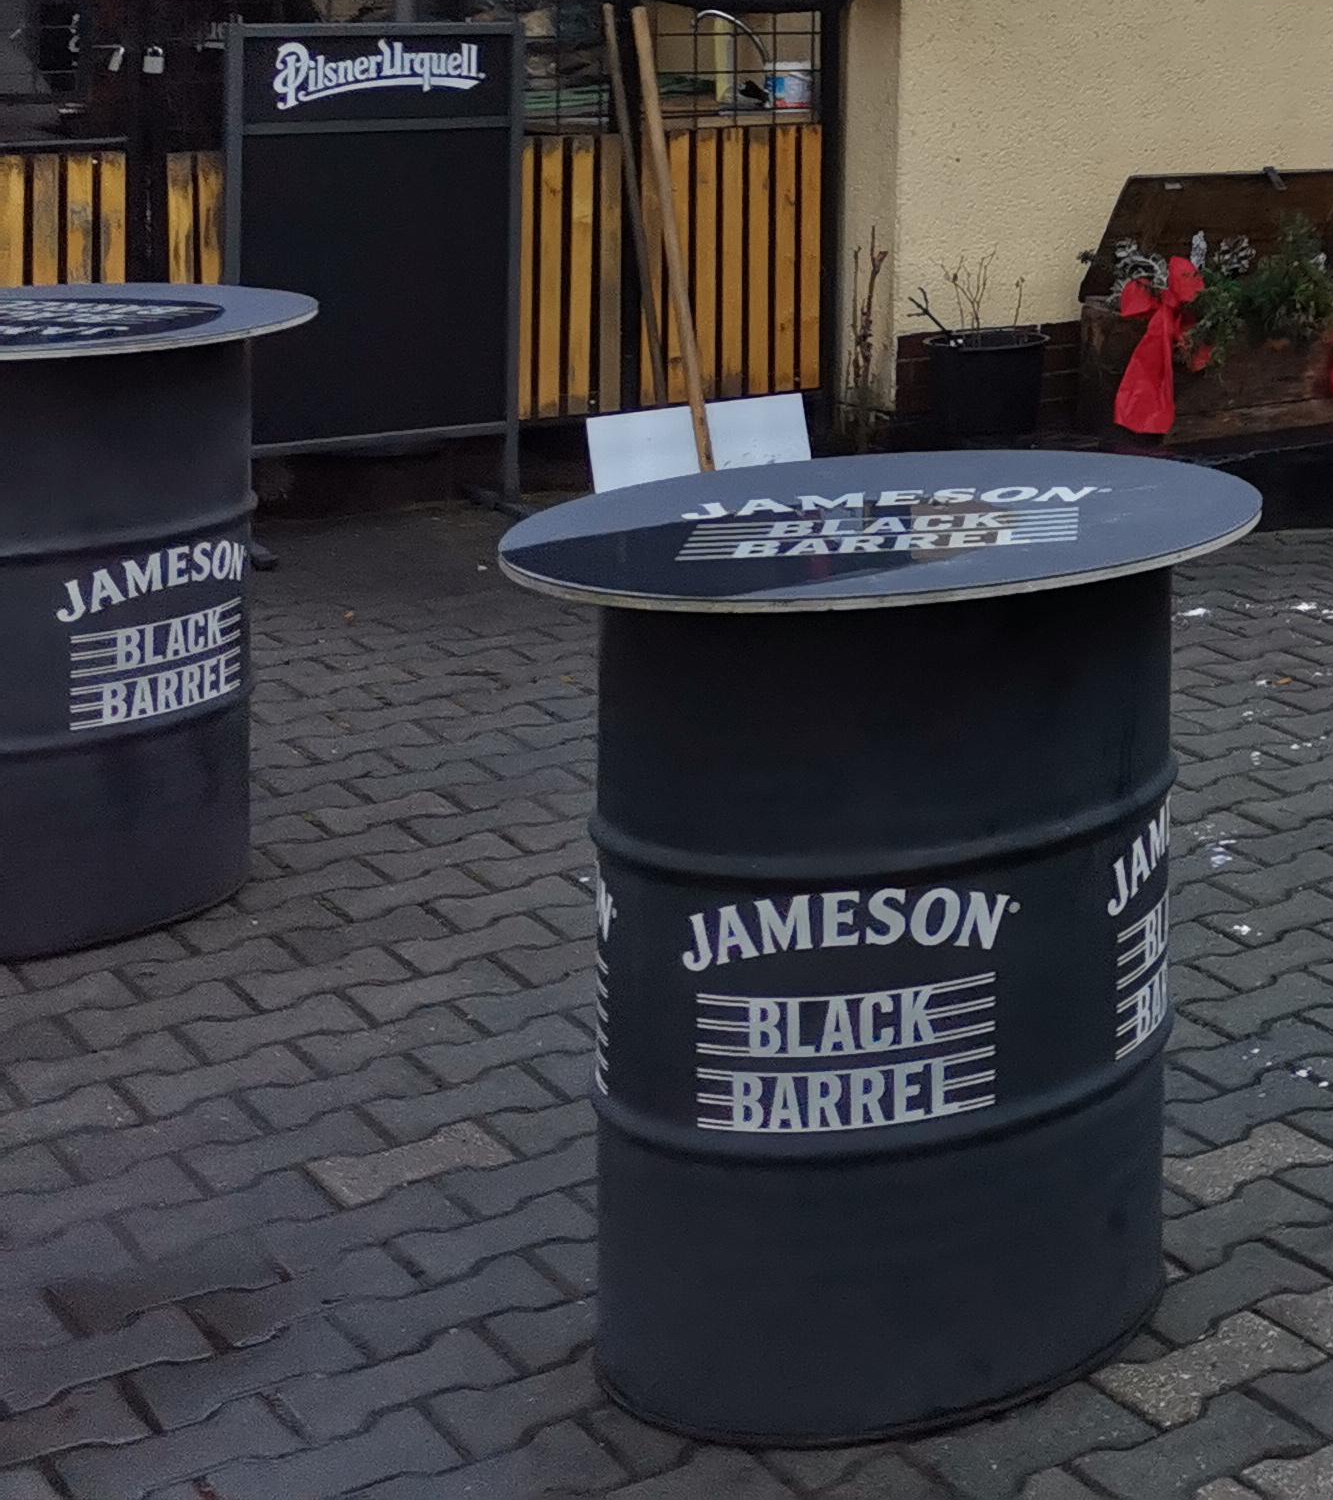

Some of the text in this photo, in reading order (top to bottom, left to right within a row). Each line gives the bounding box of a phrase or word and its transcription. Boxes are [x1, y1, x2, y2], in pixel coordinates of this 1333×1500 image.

[272, 38, 480, 111] Pilsner Urquell
[680, 485, 1100, 521] JAMESON
[766, 511, 1008, 537] BLACK
[731, 528, 1032, 559] BARREL
[55, 539, 246, 623] JAMESON
[115, 608, 223, 670] BLACK
[101, 657, 232, 725] BARREL
[681, 886, 1011, 973] JAMESON
[747, 986, 935, 1058] BLACK
[730, 1060, 957, 1132] BARREL
